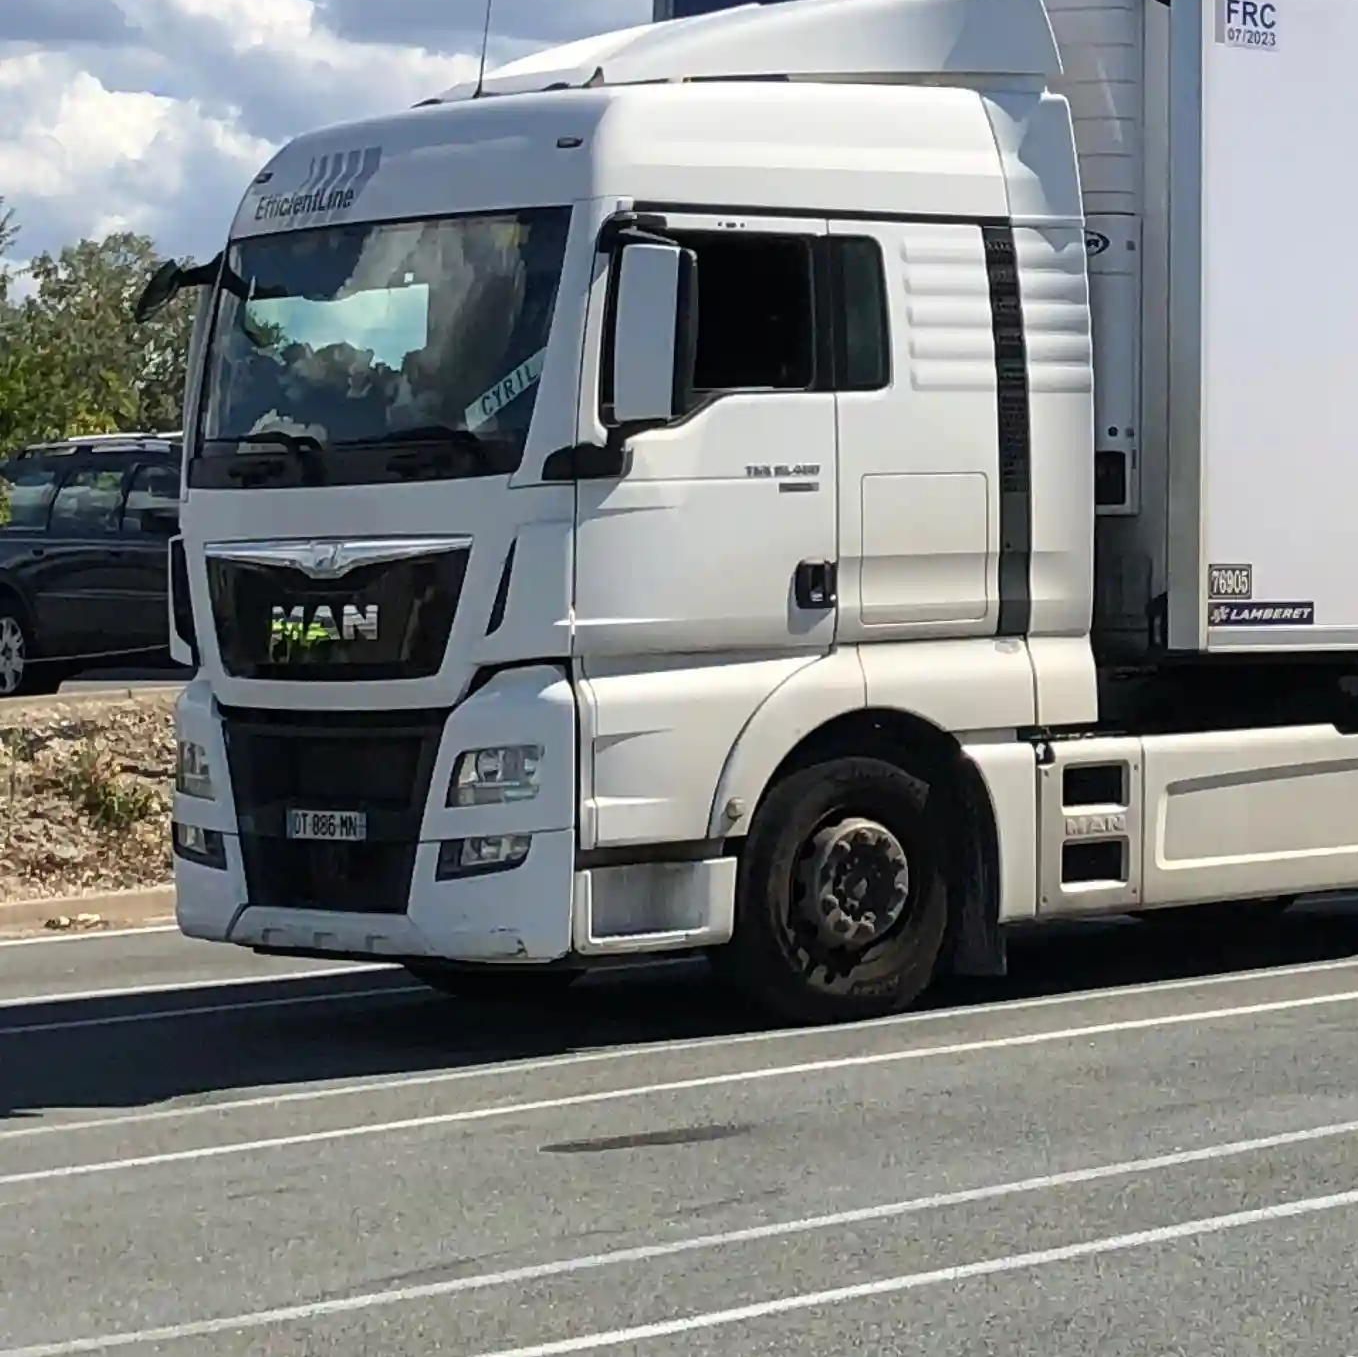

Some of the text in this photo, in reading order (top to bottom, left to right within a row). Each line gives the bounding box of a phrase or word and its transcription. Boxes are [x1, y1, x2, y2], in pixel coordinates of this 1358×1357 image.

[1227, 27, 1276, 46] 07/2023
[255, 187, 354, 220] EfficientLine
[481, 364, 539, 416] CYRIL
[1211, 569, 1249, 594] 76905
[271, 604, 379, 641] MAN
[1230, 607, 1313, 620] LAMBERET
